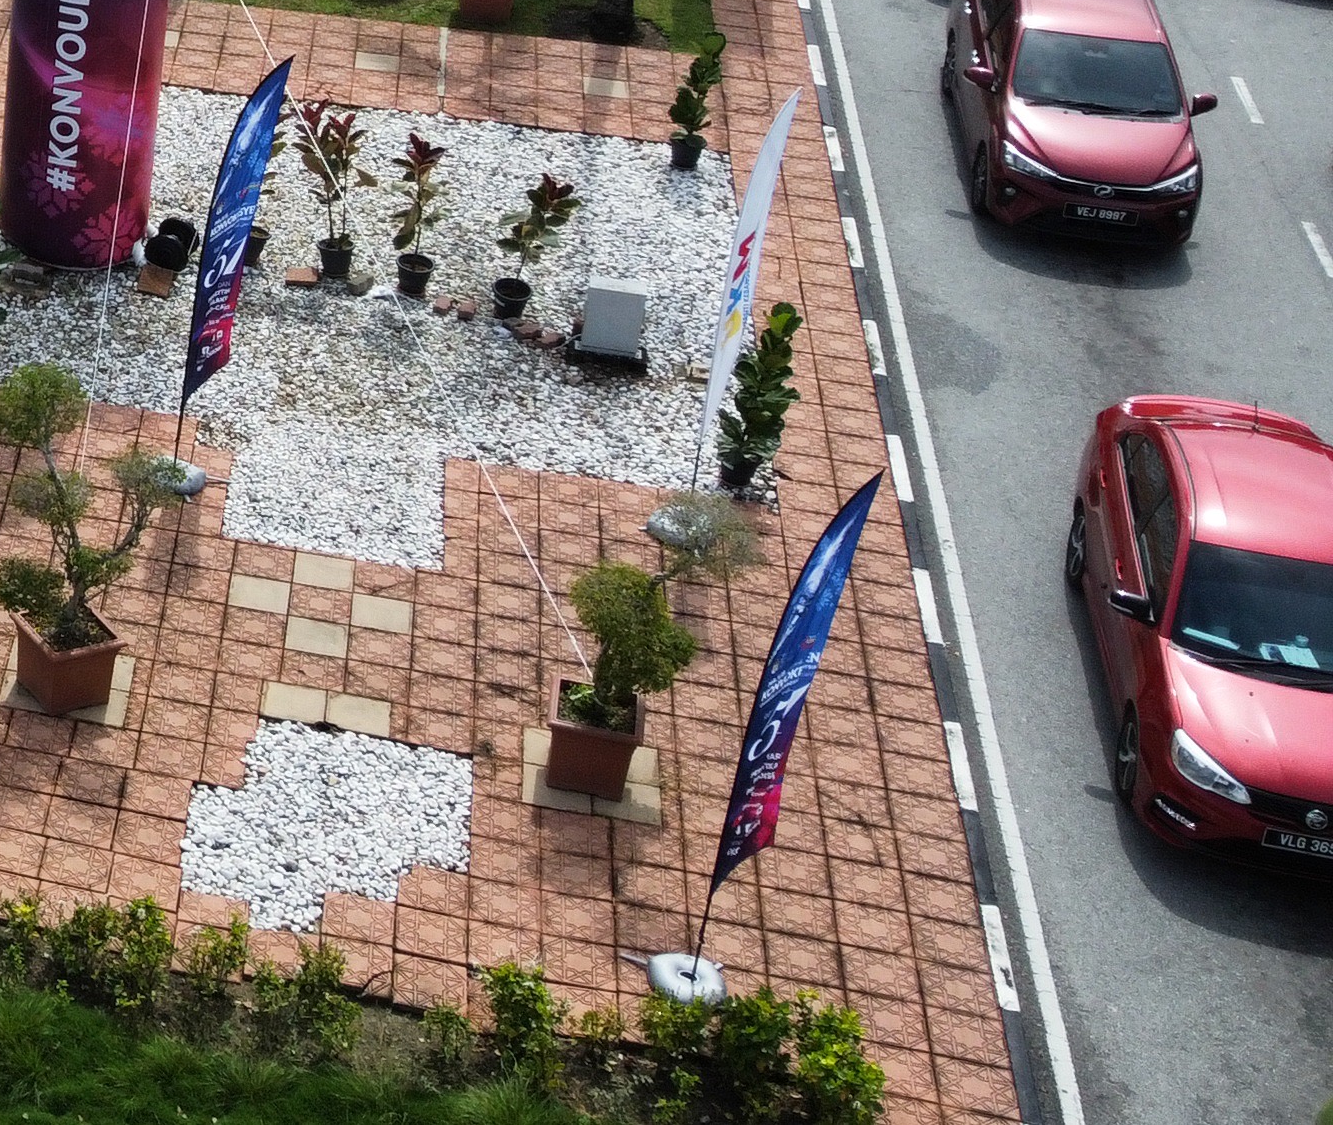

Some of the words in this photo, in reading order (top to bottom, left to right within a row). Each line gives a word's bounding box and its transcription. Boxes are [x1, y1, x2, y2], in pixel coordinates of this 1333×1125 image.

[1077, 206, 1097, 218] VEJ
[203, 234, 248, 289] 51
[1280, 833, 1307, 849] VLG
